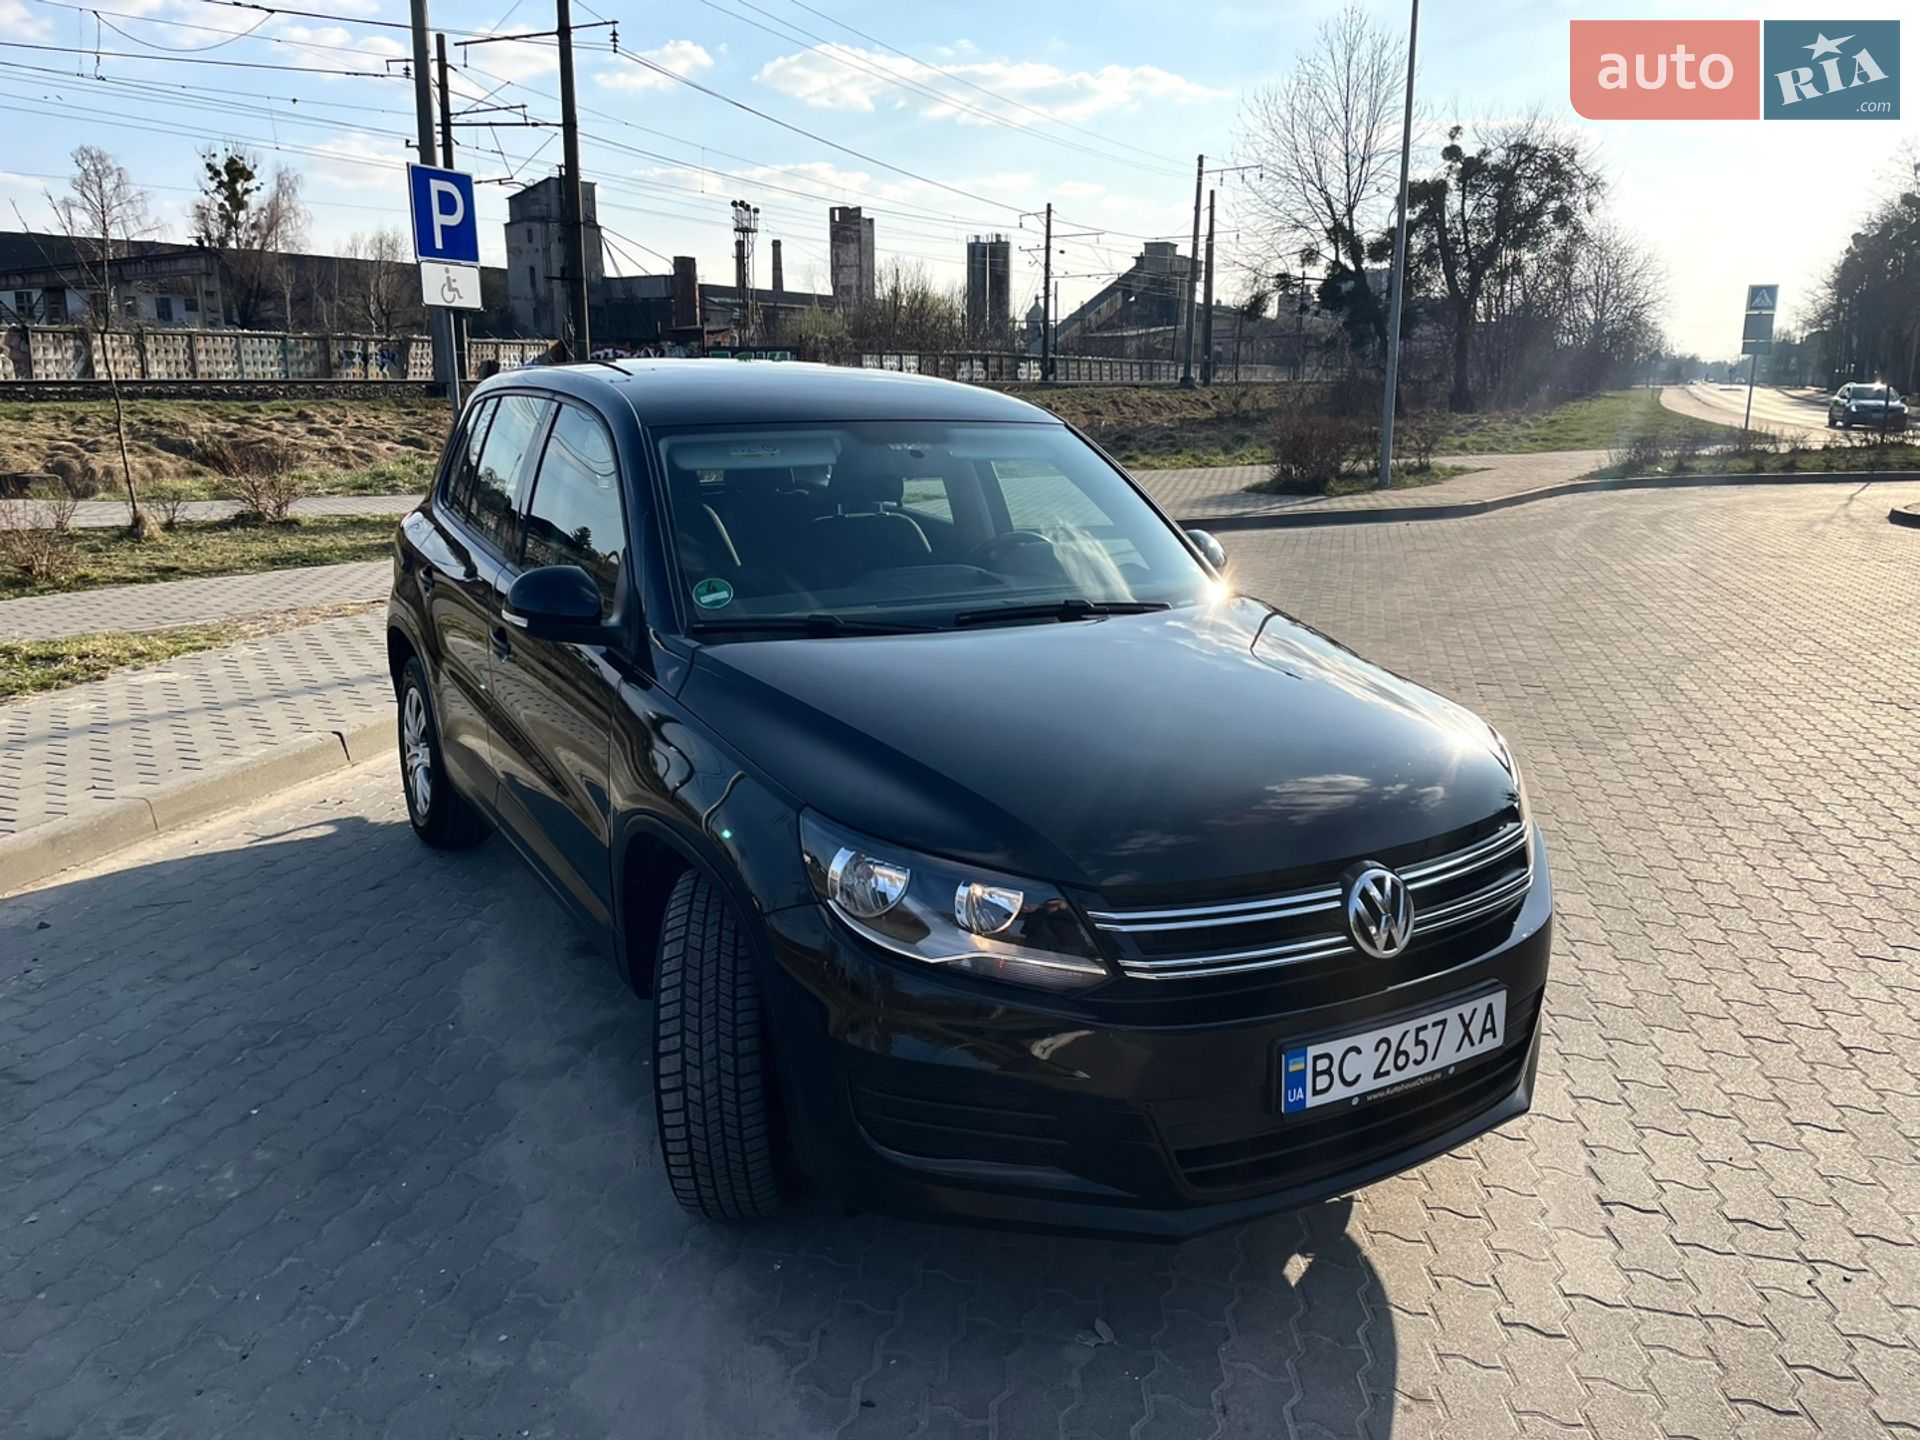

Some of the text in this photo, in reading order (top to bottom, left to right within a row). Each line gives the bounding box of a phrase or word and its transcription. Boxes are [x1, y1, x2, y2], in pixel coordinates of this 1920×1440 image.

[429, 178, 465, 250] P
[1311, 1002, 1498, 1098] BC 2657 XA
[1287, 1086, 1305, 1103] UA
